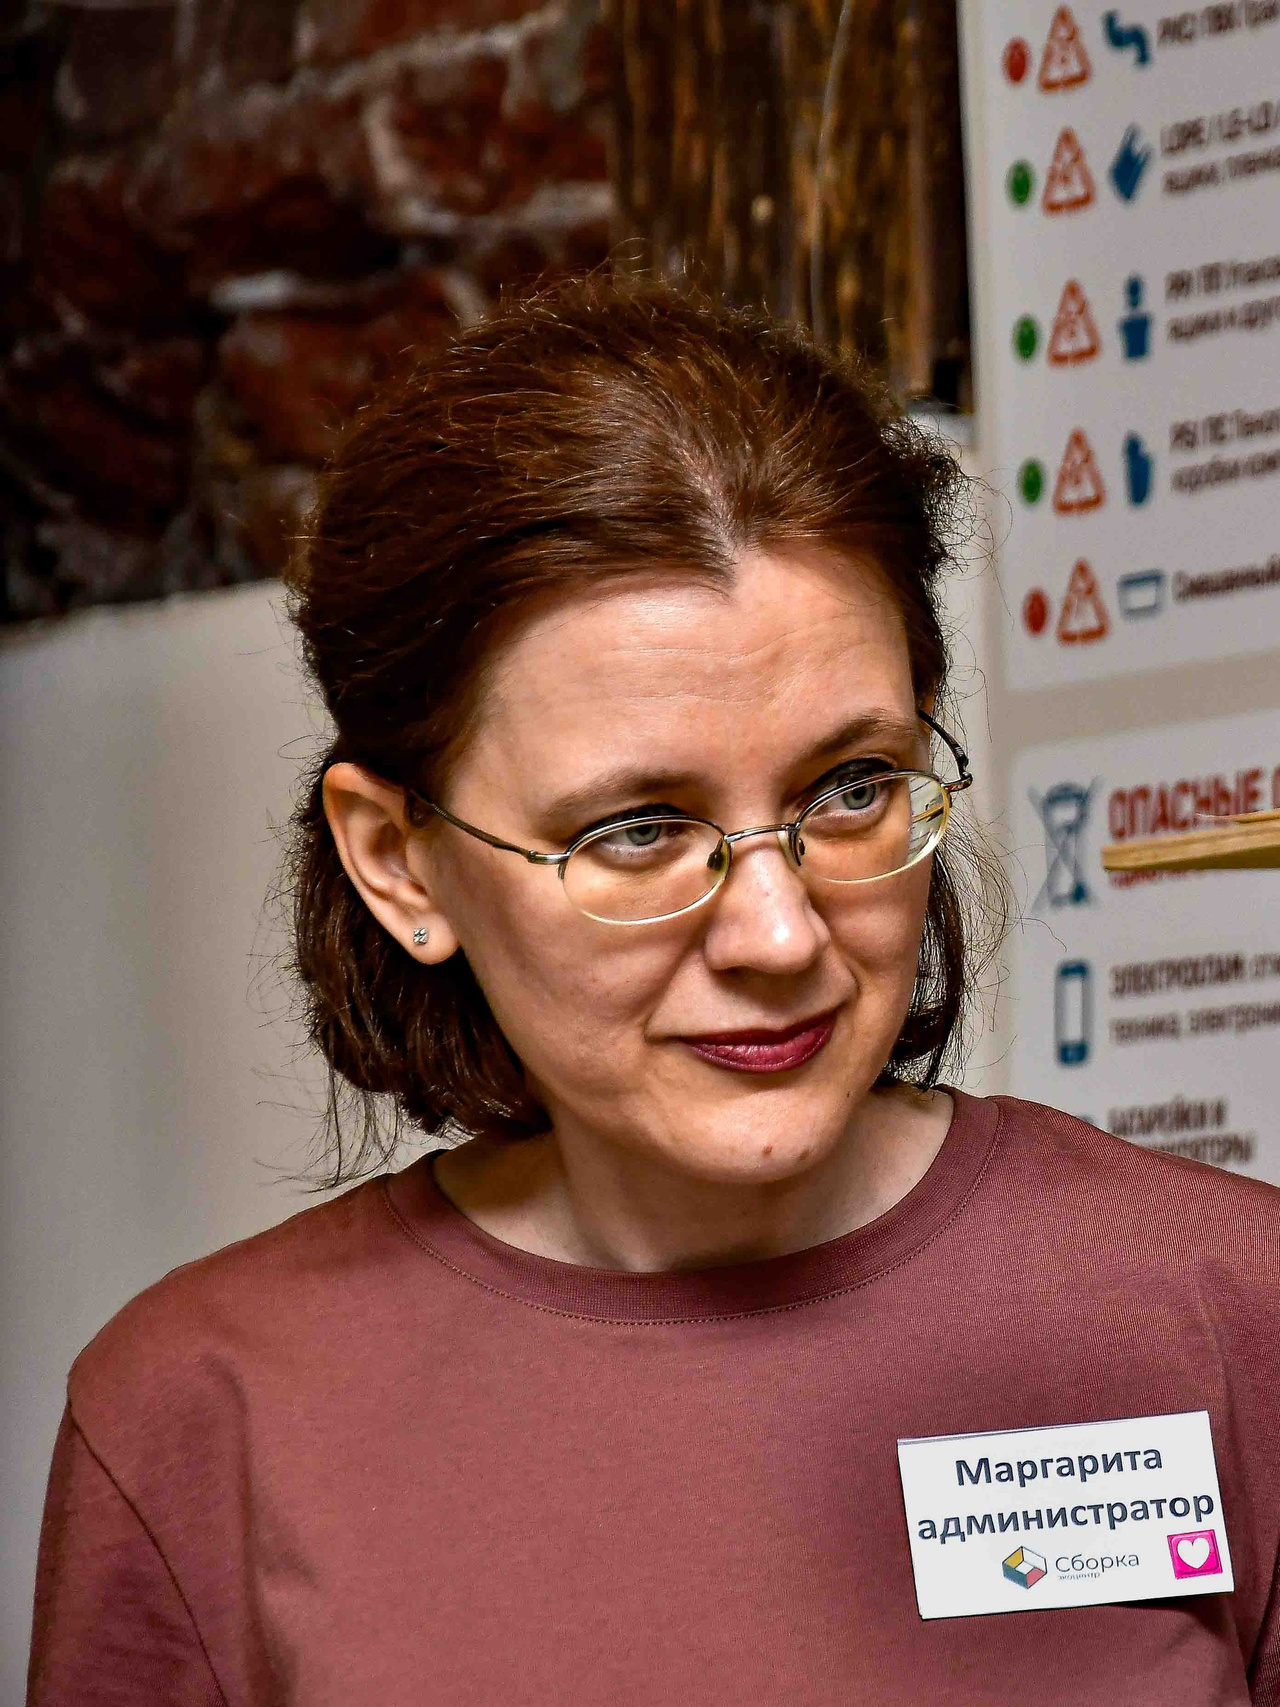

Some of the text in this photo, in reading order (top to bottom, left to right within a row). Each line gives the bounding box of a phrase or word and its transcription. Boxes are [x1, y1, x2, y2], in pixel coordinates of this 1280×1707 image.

[1107, 766, 1262, 841] ОПАСНЫЕ
[955, 1448, 1163, 1488] Маргарита
[918, 1493, 1215, 1545] администратор
[1055, 1553, 1140, 1573] Сборка
